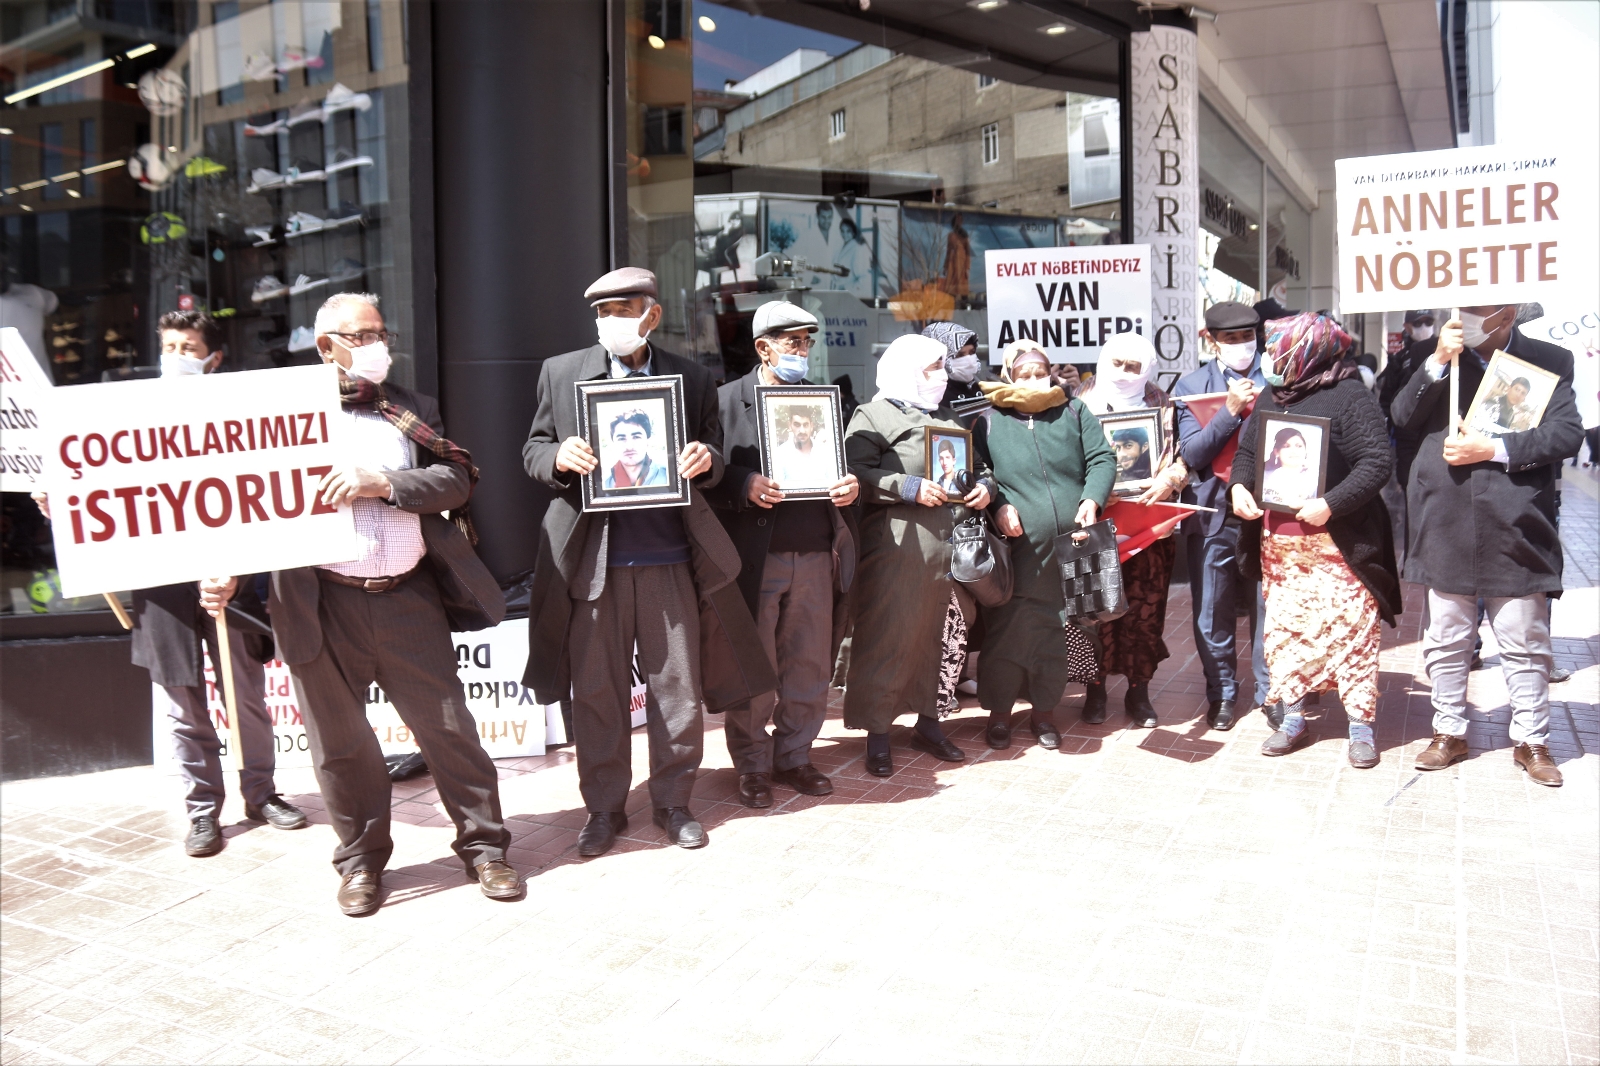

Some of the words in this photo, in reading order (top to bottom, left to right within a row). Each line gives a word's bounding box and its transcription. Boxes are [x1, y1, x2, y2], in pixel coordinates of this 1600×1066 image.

[1351, 181, 1559, 236] ANNELER
[997, 261, 1037, 277] EVLAT
[1355, 240, 1558, 293] NÖBETTE
[1035, 281, 1099, 312] VAN
[59, 412, 329, 480] ÇOCUKLARIMIZI
